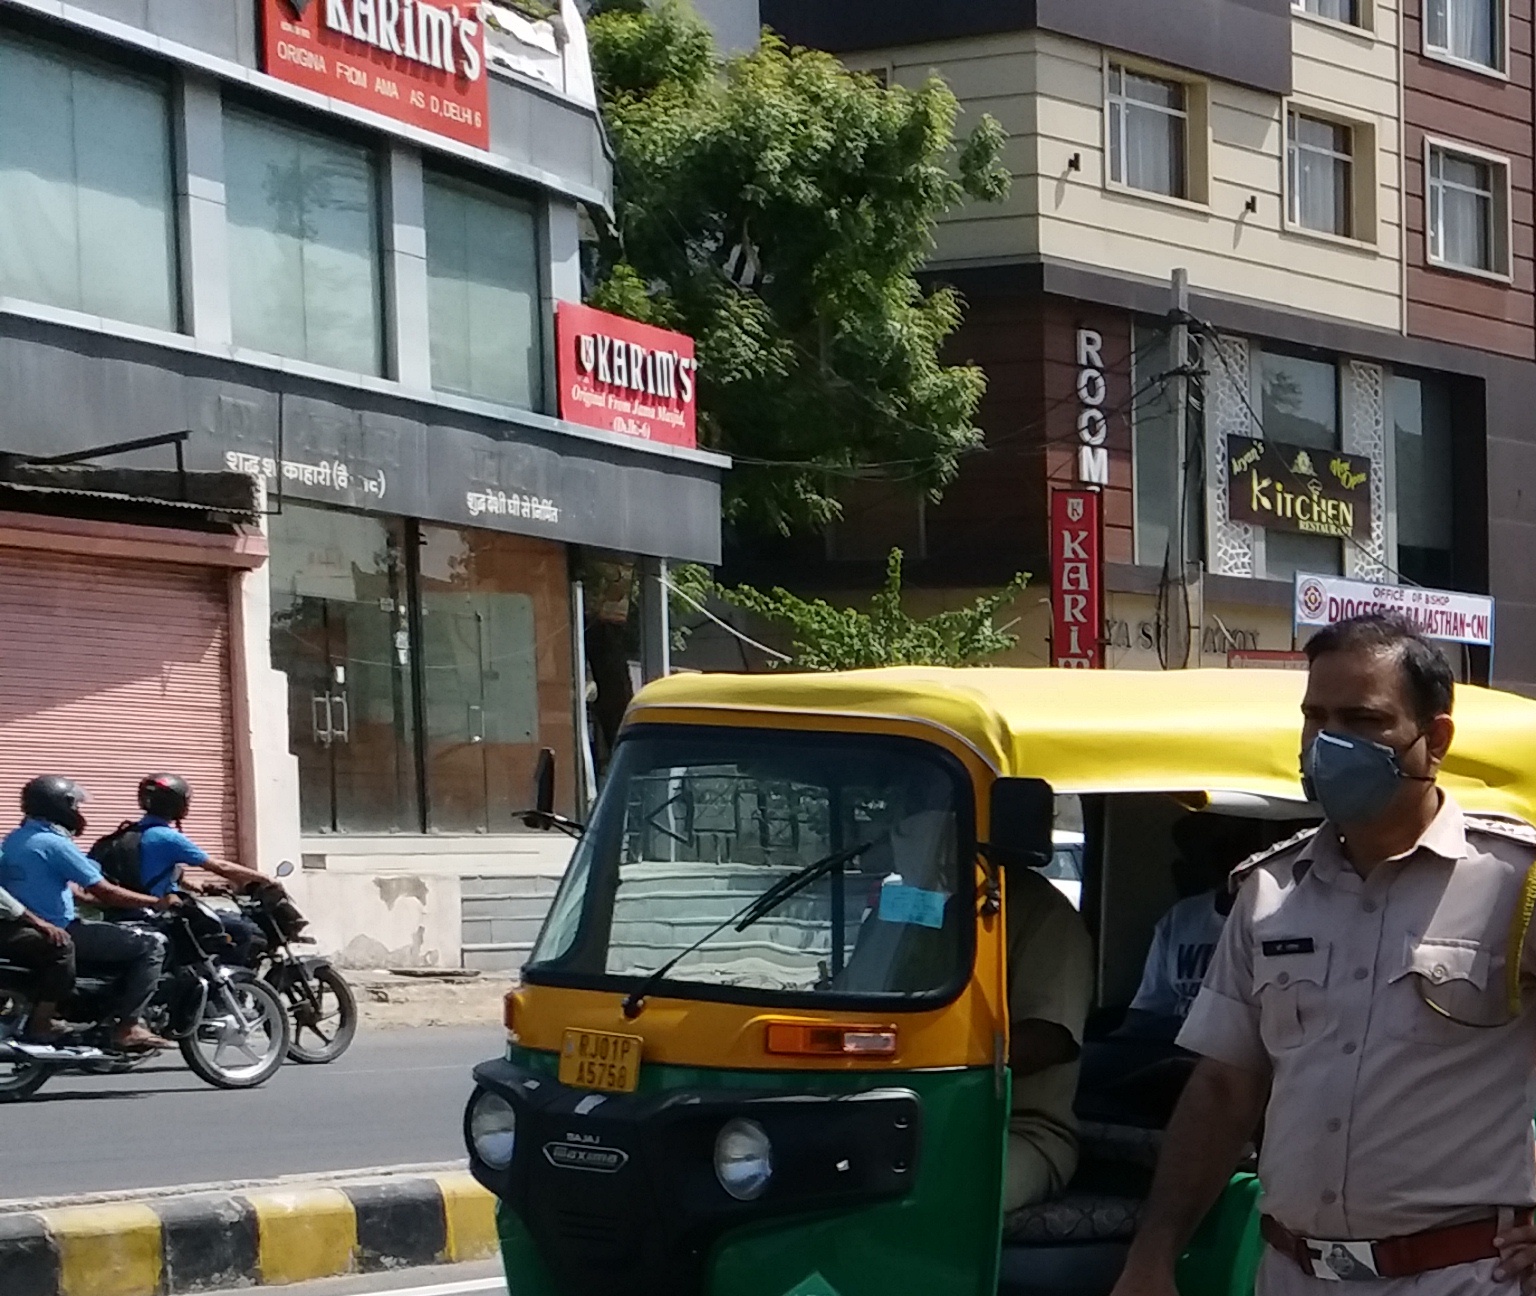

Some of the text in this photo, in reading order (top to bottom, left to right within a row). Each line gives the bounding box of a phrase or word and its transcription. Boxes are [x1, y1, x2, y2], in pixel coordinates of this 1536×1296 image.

[336, 61, 367, 89] FROM
[374, 77, 399, 100] AMA
[409, 89, 425, 109] AS
[608, 393, 631, 413] From
[1076, 328, 1109, 491] ROOM
[1373, 586, 1404, 602] OFFICE
[1425, 594, 1450, 606] BISHOP
